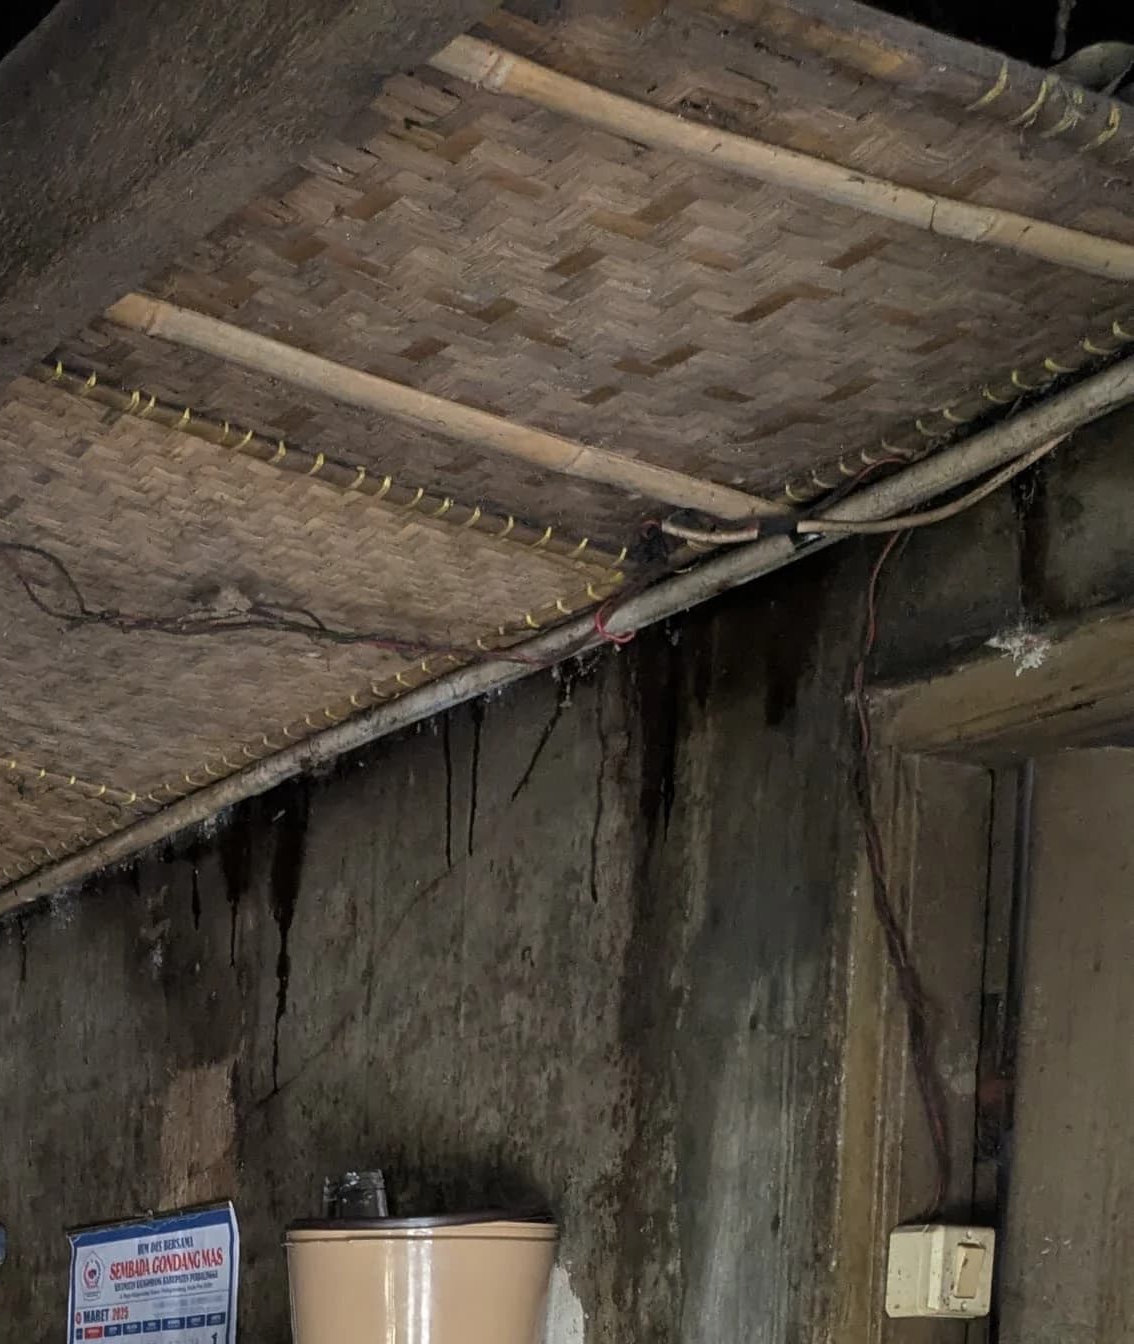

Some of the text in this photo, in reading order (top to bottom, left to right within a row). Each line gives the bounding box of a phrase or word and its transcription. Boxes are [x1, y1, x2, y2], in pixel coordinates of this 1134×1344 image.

[109, 1247, 223, 1281] SEMBADA GONDANG MAS
[83, 1308, 110, 1324] MARET
[112, 1306, 129, 1321] 2025
